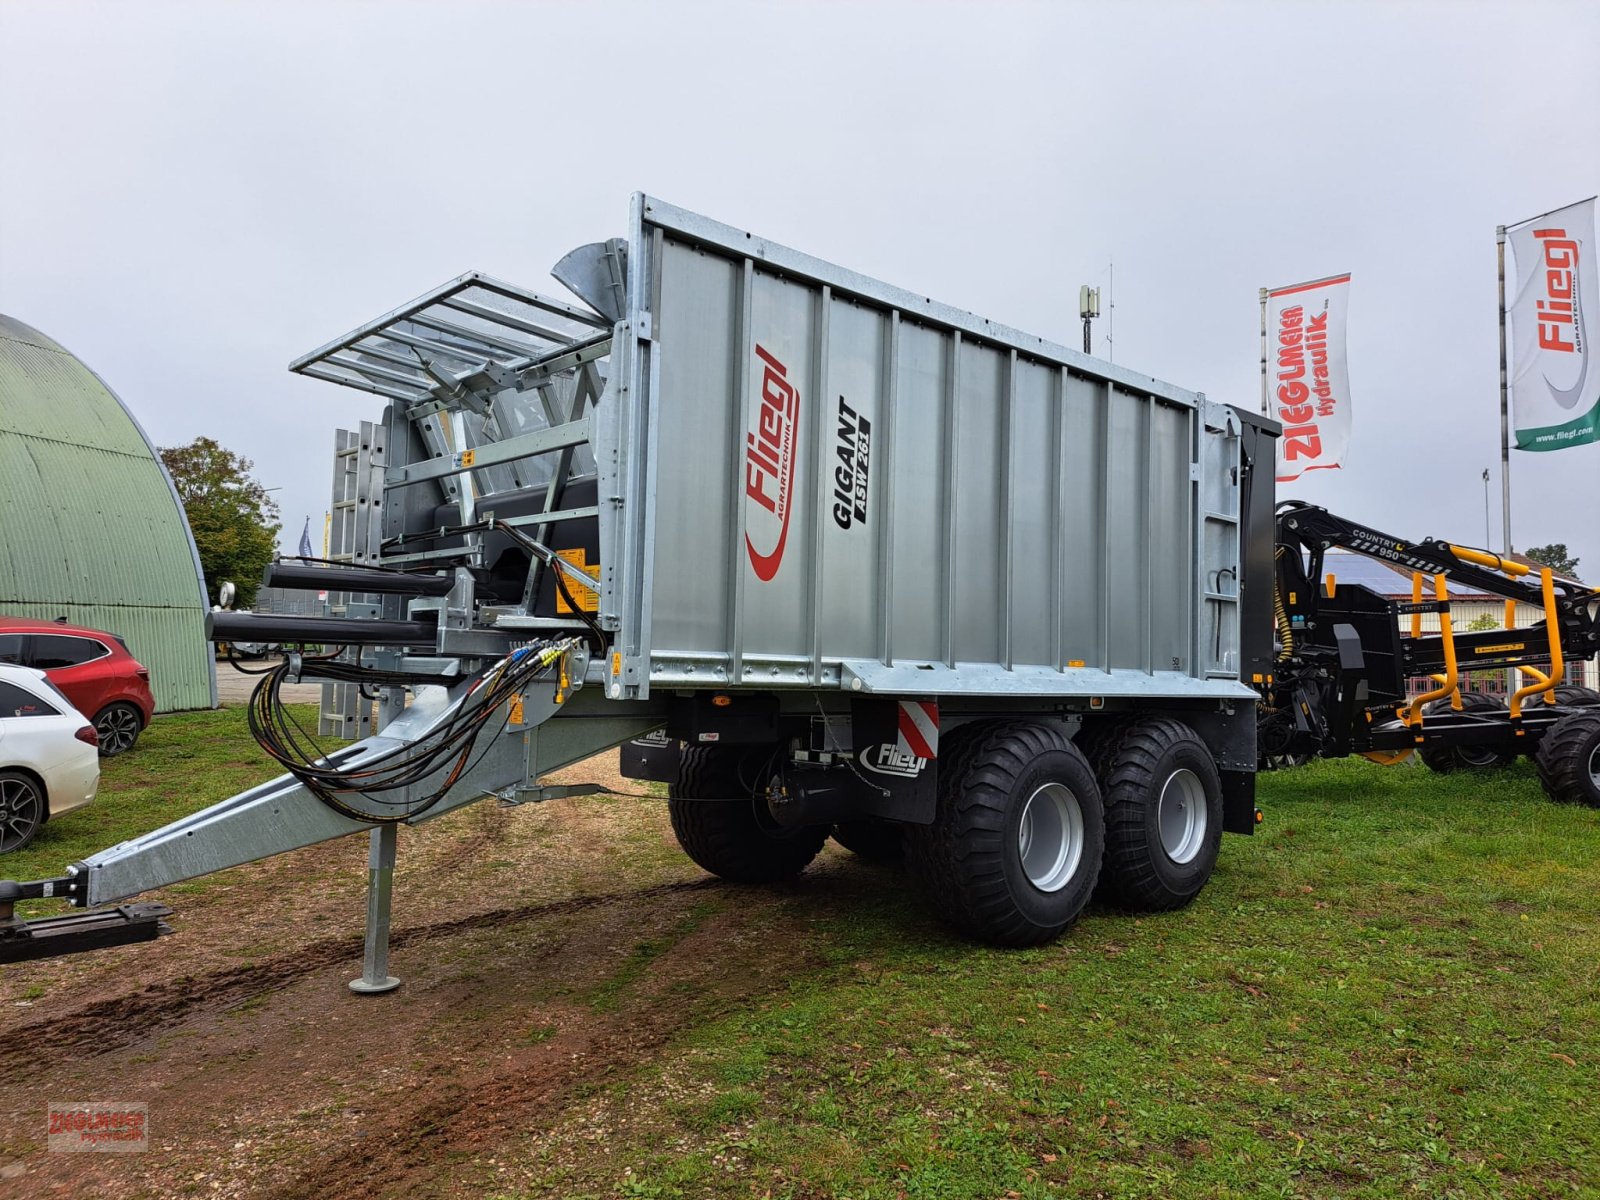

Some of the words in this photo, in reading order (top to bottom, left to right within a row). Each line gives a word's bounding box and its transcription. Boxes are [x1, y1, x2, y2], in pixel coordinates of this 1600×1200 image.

[1533, 229, 1579, 353] Fliegl
[1277, 305, 1323, 461] ZIEGLMEIER
[1305, 311, 1337, 417] Hydraulik
[746, 343, 794, 514] Fliegl
[777, 422, 792, 521] AGRARTECHNIK
[833, 395, 857, 530] GIGANT
[858, 432, 869, 467] 261
[1535, 426, 1594, 443] www.fliegl.com
[855, 467, 868, 514] ASW
[1352, 529, 1397, 549] COUNTRY
[1379, 547, 1400, 561] 950
